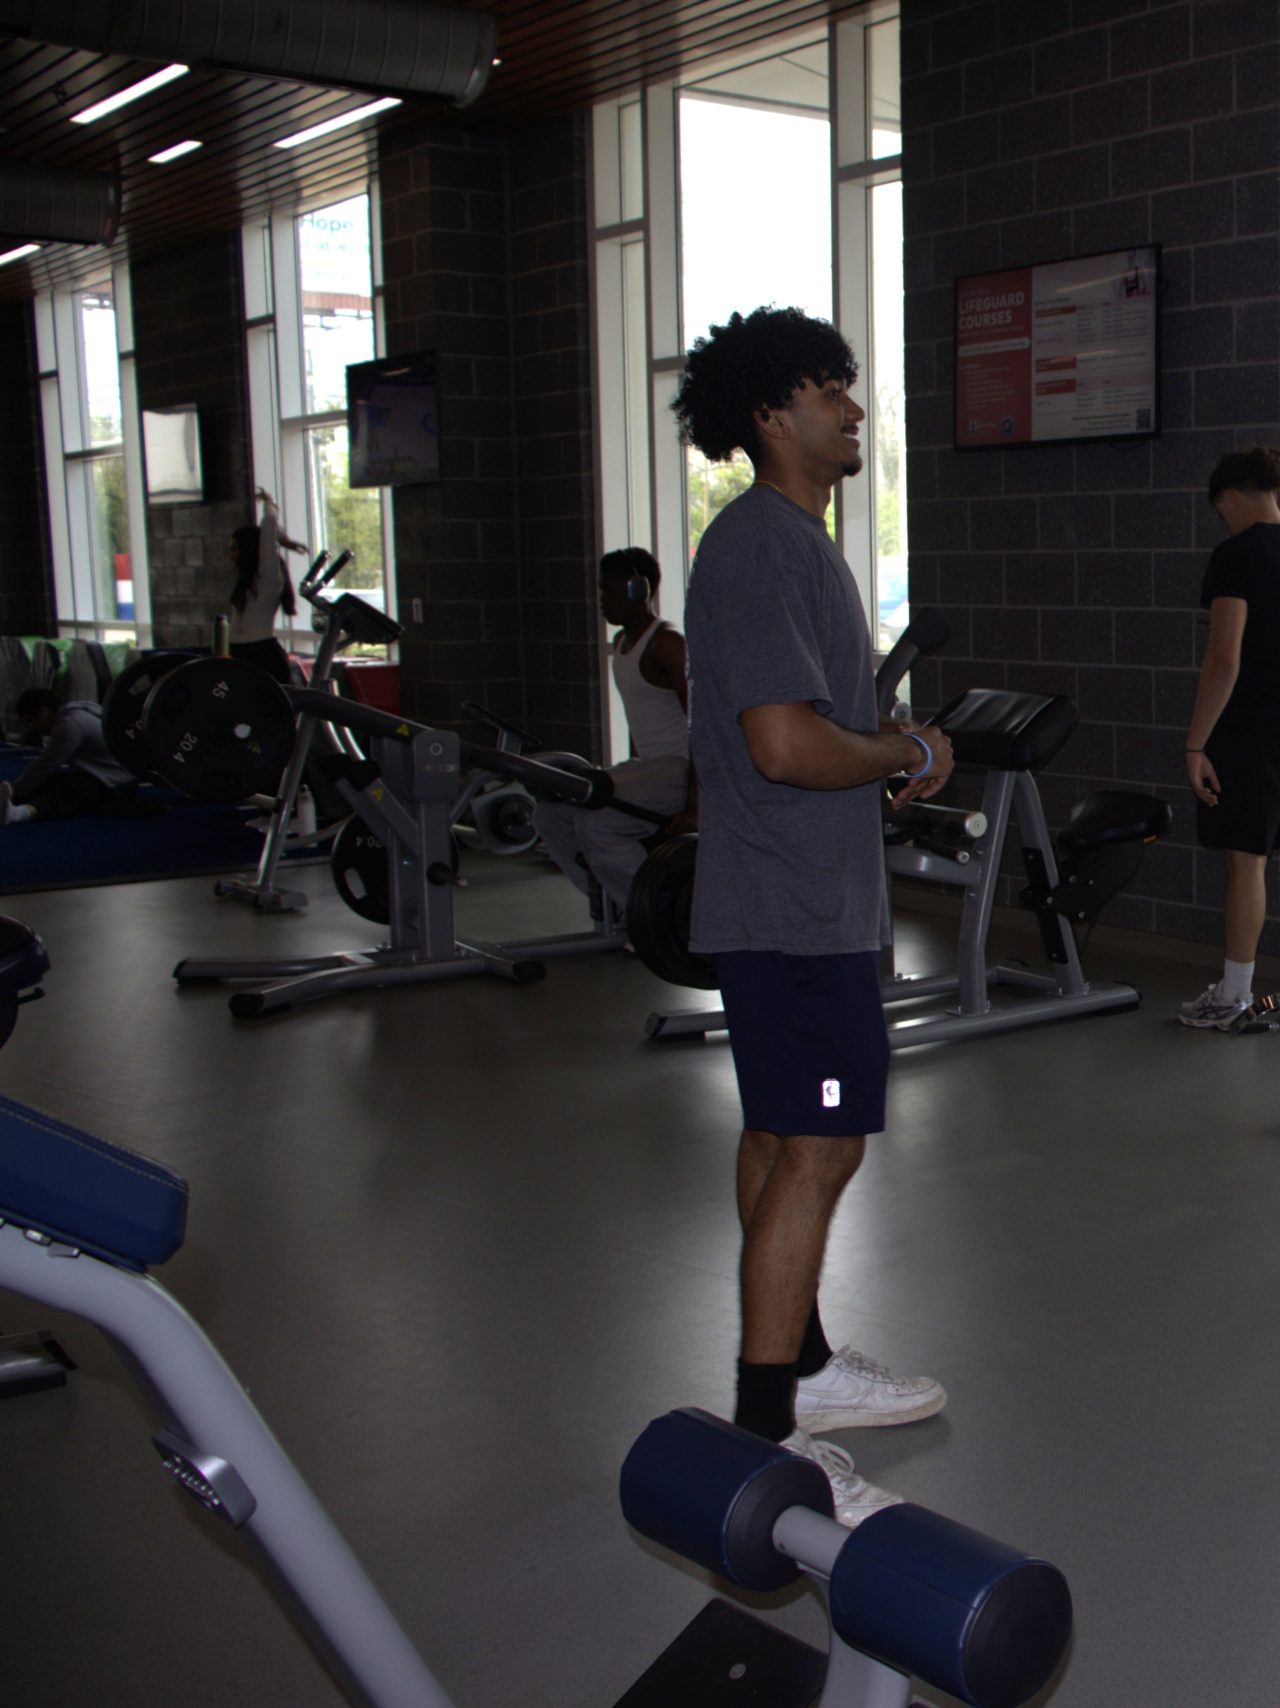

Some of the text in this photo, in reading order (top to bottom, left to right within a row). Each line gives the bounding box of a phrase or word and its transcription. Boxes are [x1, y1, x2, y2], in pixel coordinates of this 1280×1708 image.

[959, 292, 1025, 314] LIFEGUARD
[959, 310, 1012, 329] COURSES
[212, 680, 230, 700] 45
[172, 732, 198, 763] 20.4
